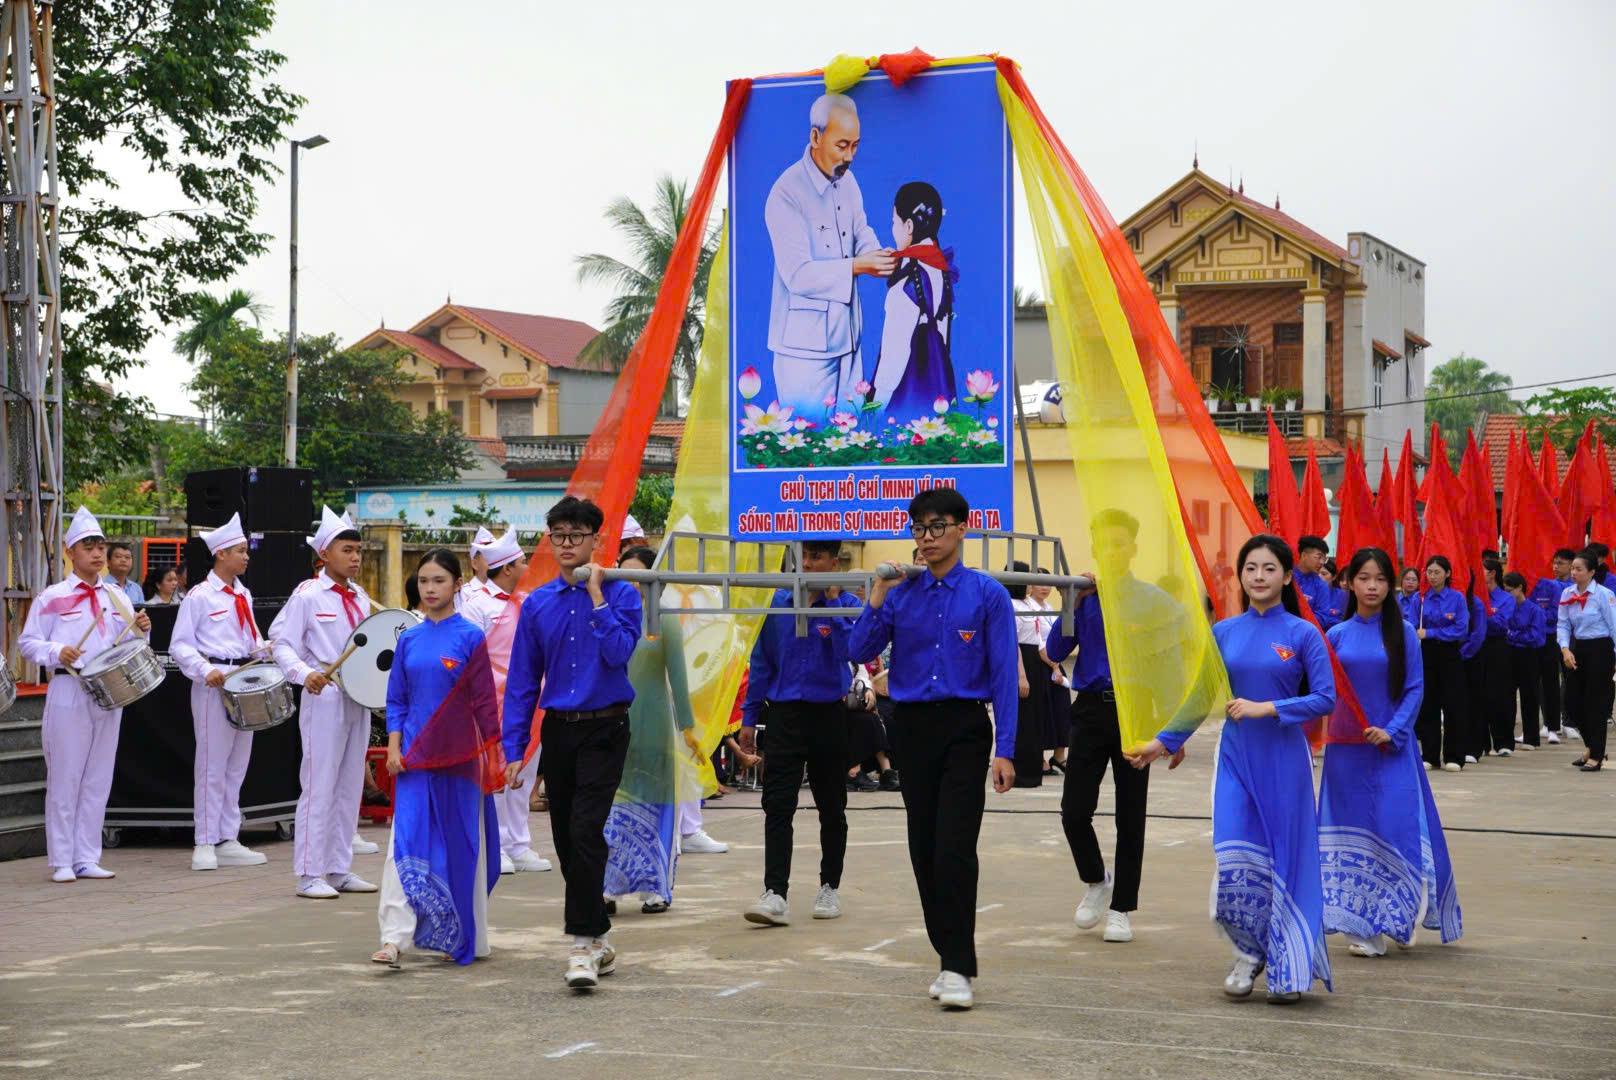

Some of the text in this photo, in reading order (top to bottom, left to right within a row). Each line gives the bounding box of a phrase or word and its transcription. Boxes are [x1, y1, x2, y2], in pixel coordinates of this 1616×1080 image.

[780, 474, 806, 502] CHỦ
[807, 479, 836, 505] TỊCH
[837, 473, 855, 501] HỒ
[857, 475, 880, 501] CHÍ
[881, 478, 915, 501] MINH
[738, 506, 772, 534] SỐNG
[774, 508, 799, 533] MÃI
[801, 511, 842, 532] TRONG
[843, 509, 863, 536] SỰ
[863, 507, 910, 536] NGHIỆP
[985, 509, 1001, 530] TA
